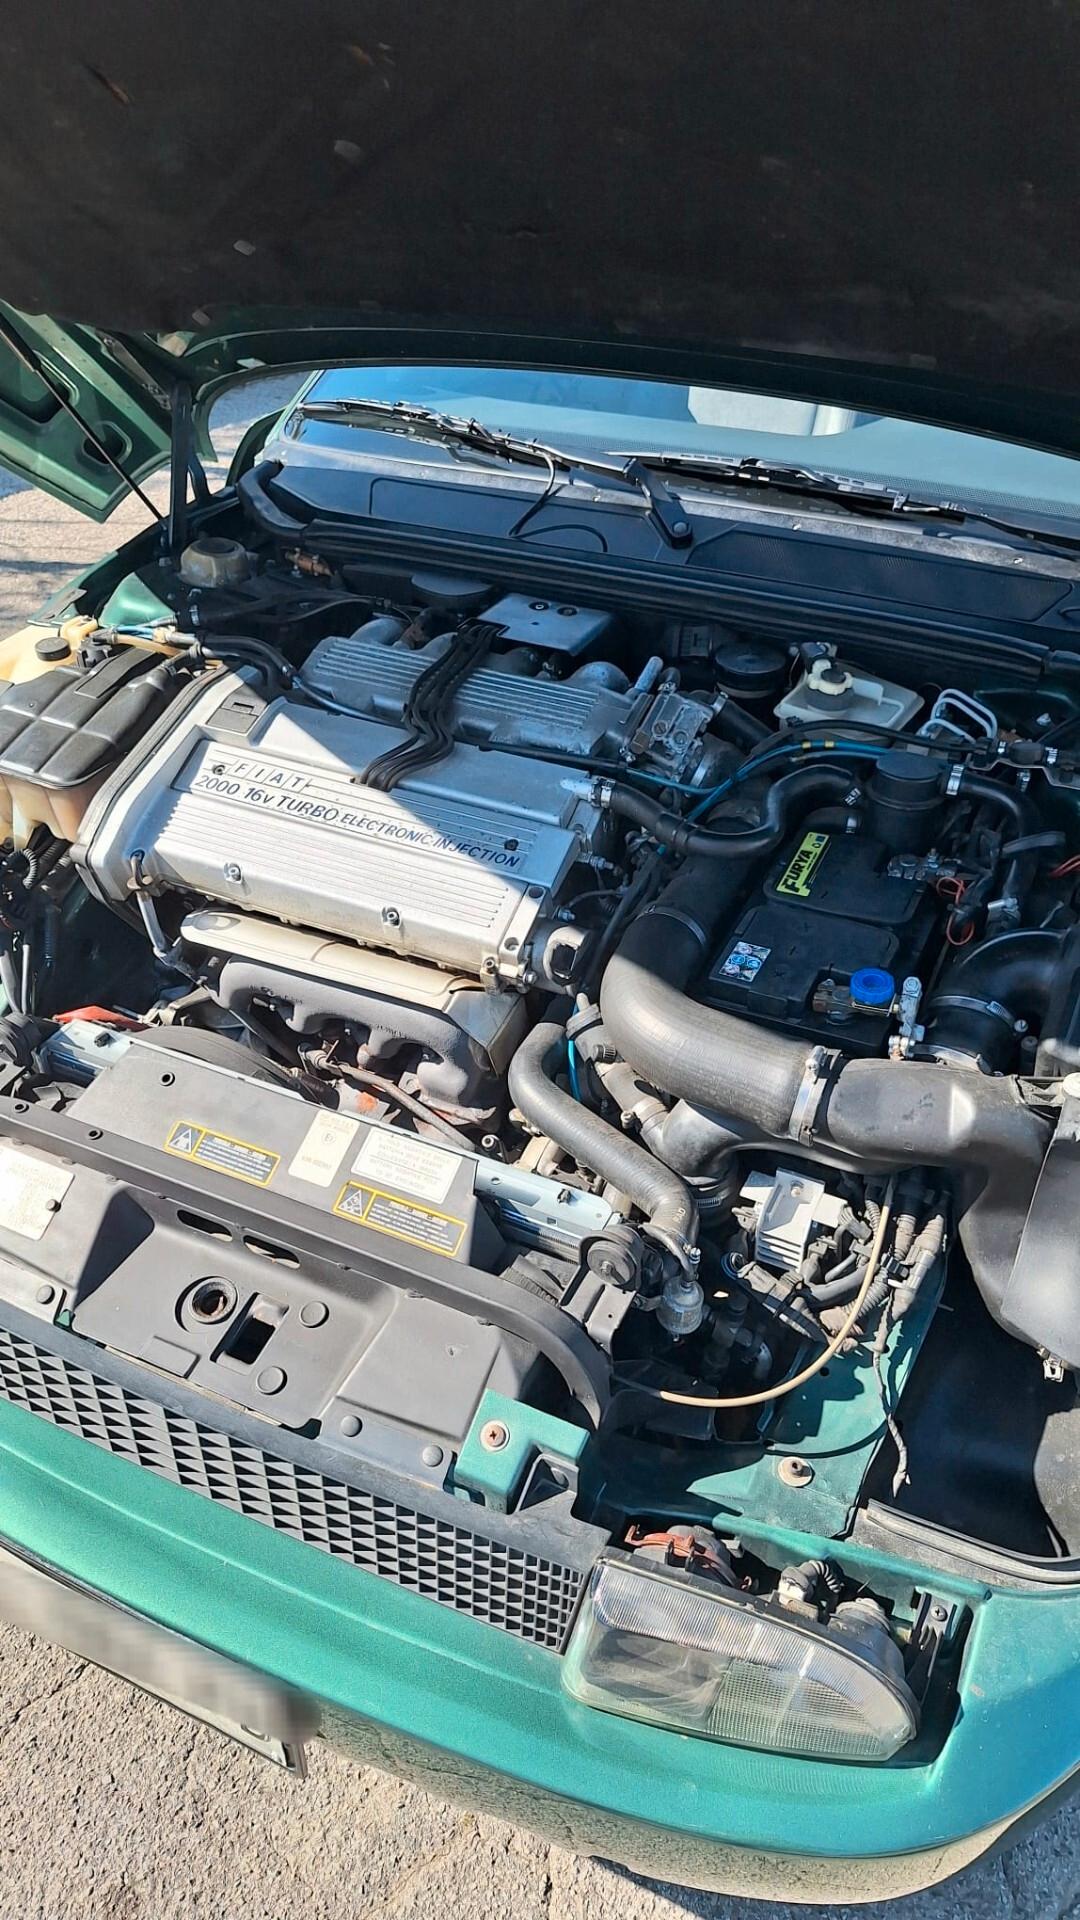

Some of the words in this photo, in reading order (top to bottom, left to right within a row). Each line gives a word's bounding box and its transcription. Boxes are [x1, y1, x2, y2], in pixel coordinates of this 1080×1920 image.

[234, 763, 305, 788] FIAT
[195, 775, 241, 796] 2000
[244, 787, 274, 805] 16v
[277, 795, 340, 822] TURBO
[340, 813, 433, 847] ELECTRONIC
[434, 837, 520, 868] INJECTION
[781, 849, 814, 893] FURYA
